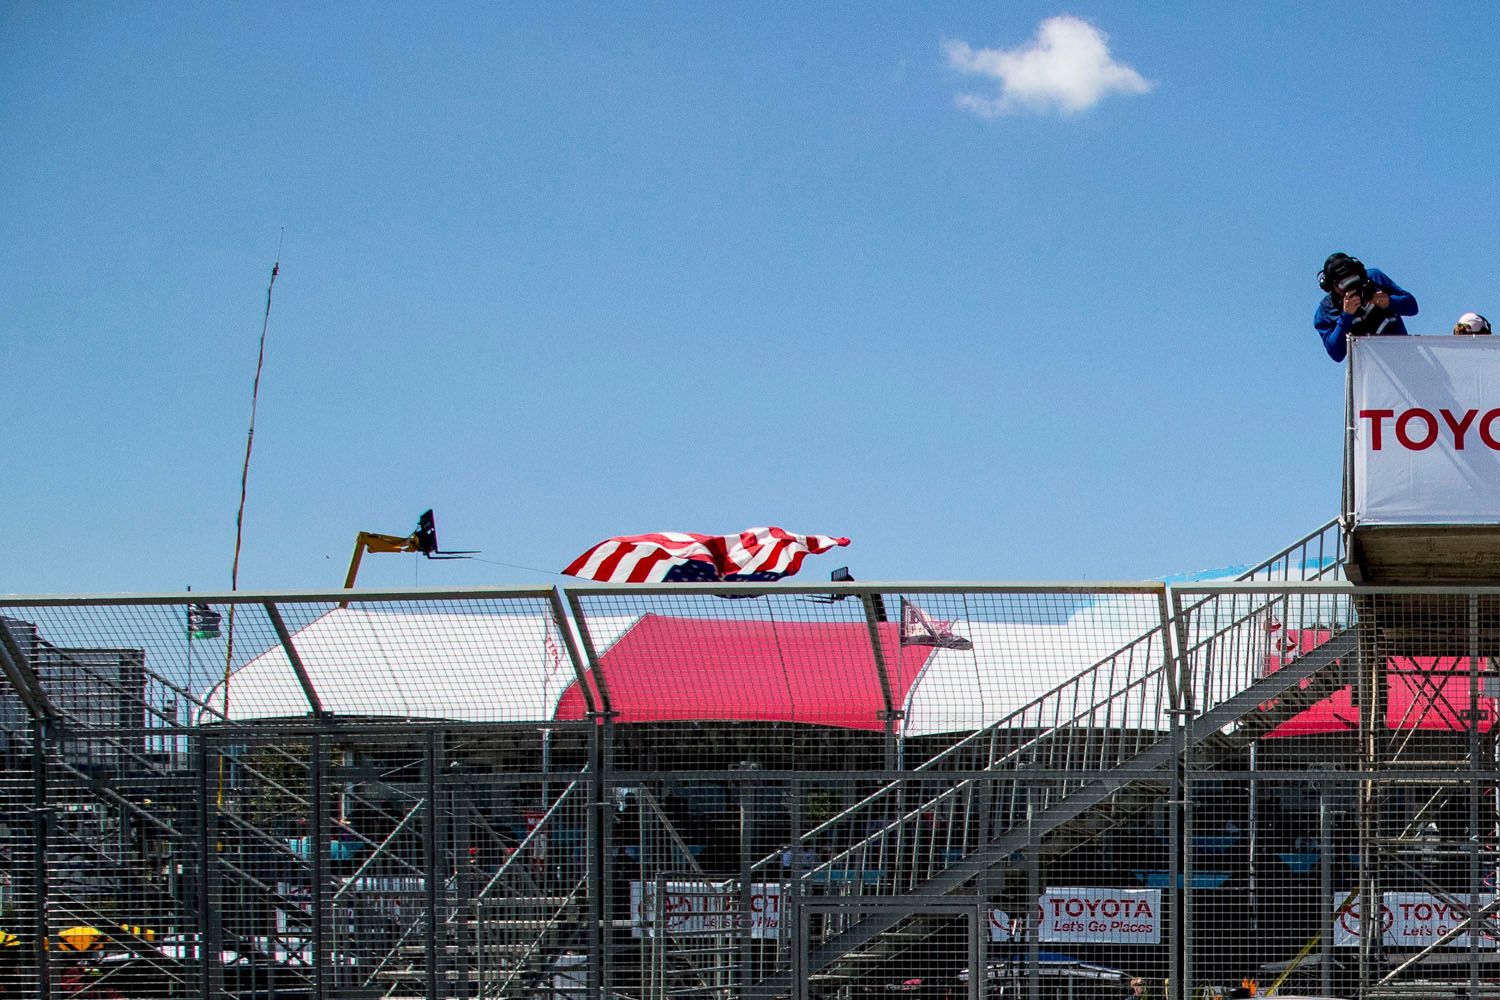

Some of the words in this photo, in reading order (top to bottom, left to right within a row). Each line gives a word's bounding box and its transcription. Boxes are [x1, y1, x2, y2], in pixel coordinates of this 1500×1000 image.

[1050, 899, 1153, 917] TOYOTA
[1053, 920, 1084, 932] Let's
[1088, 921, 1107, 932] Go
[1110, 921, 1153, 933] Places
